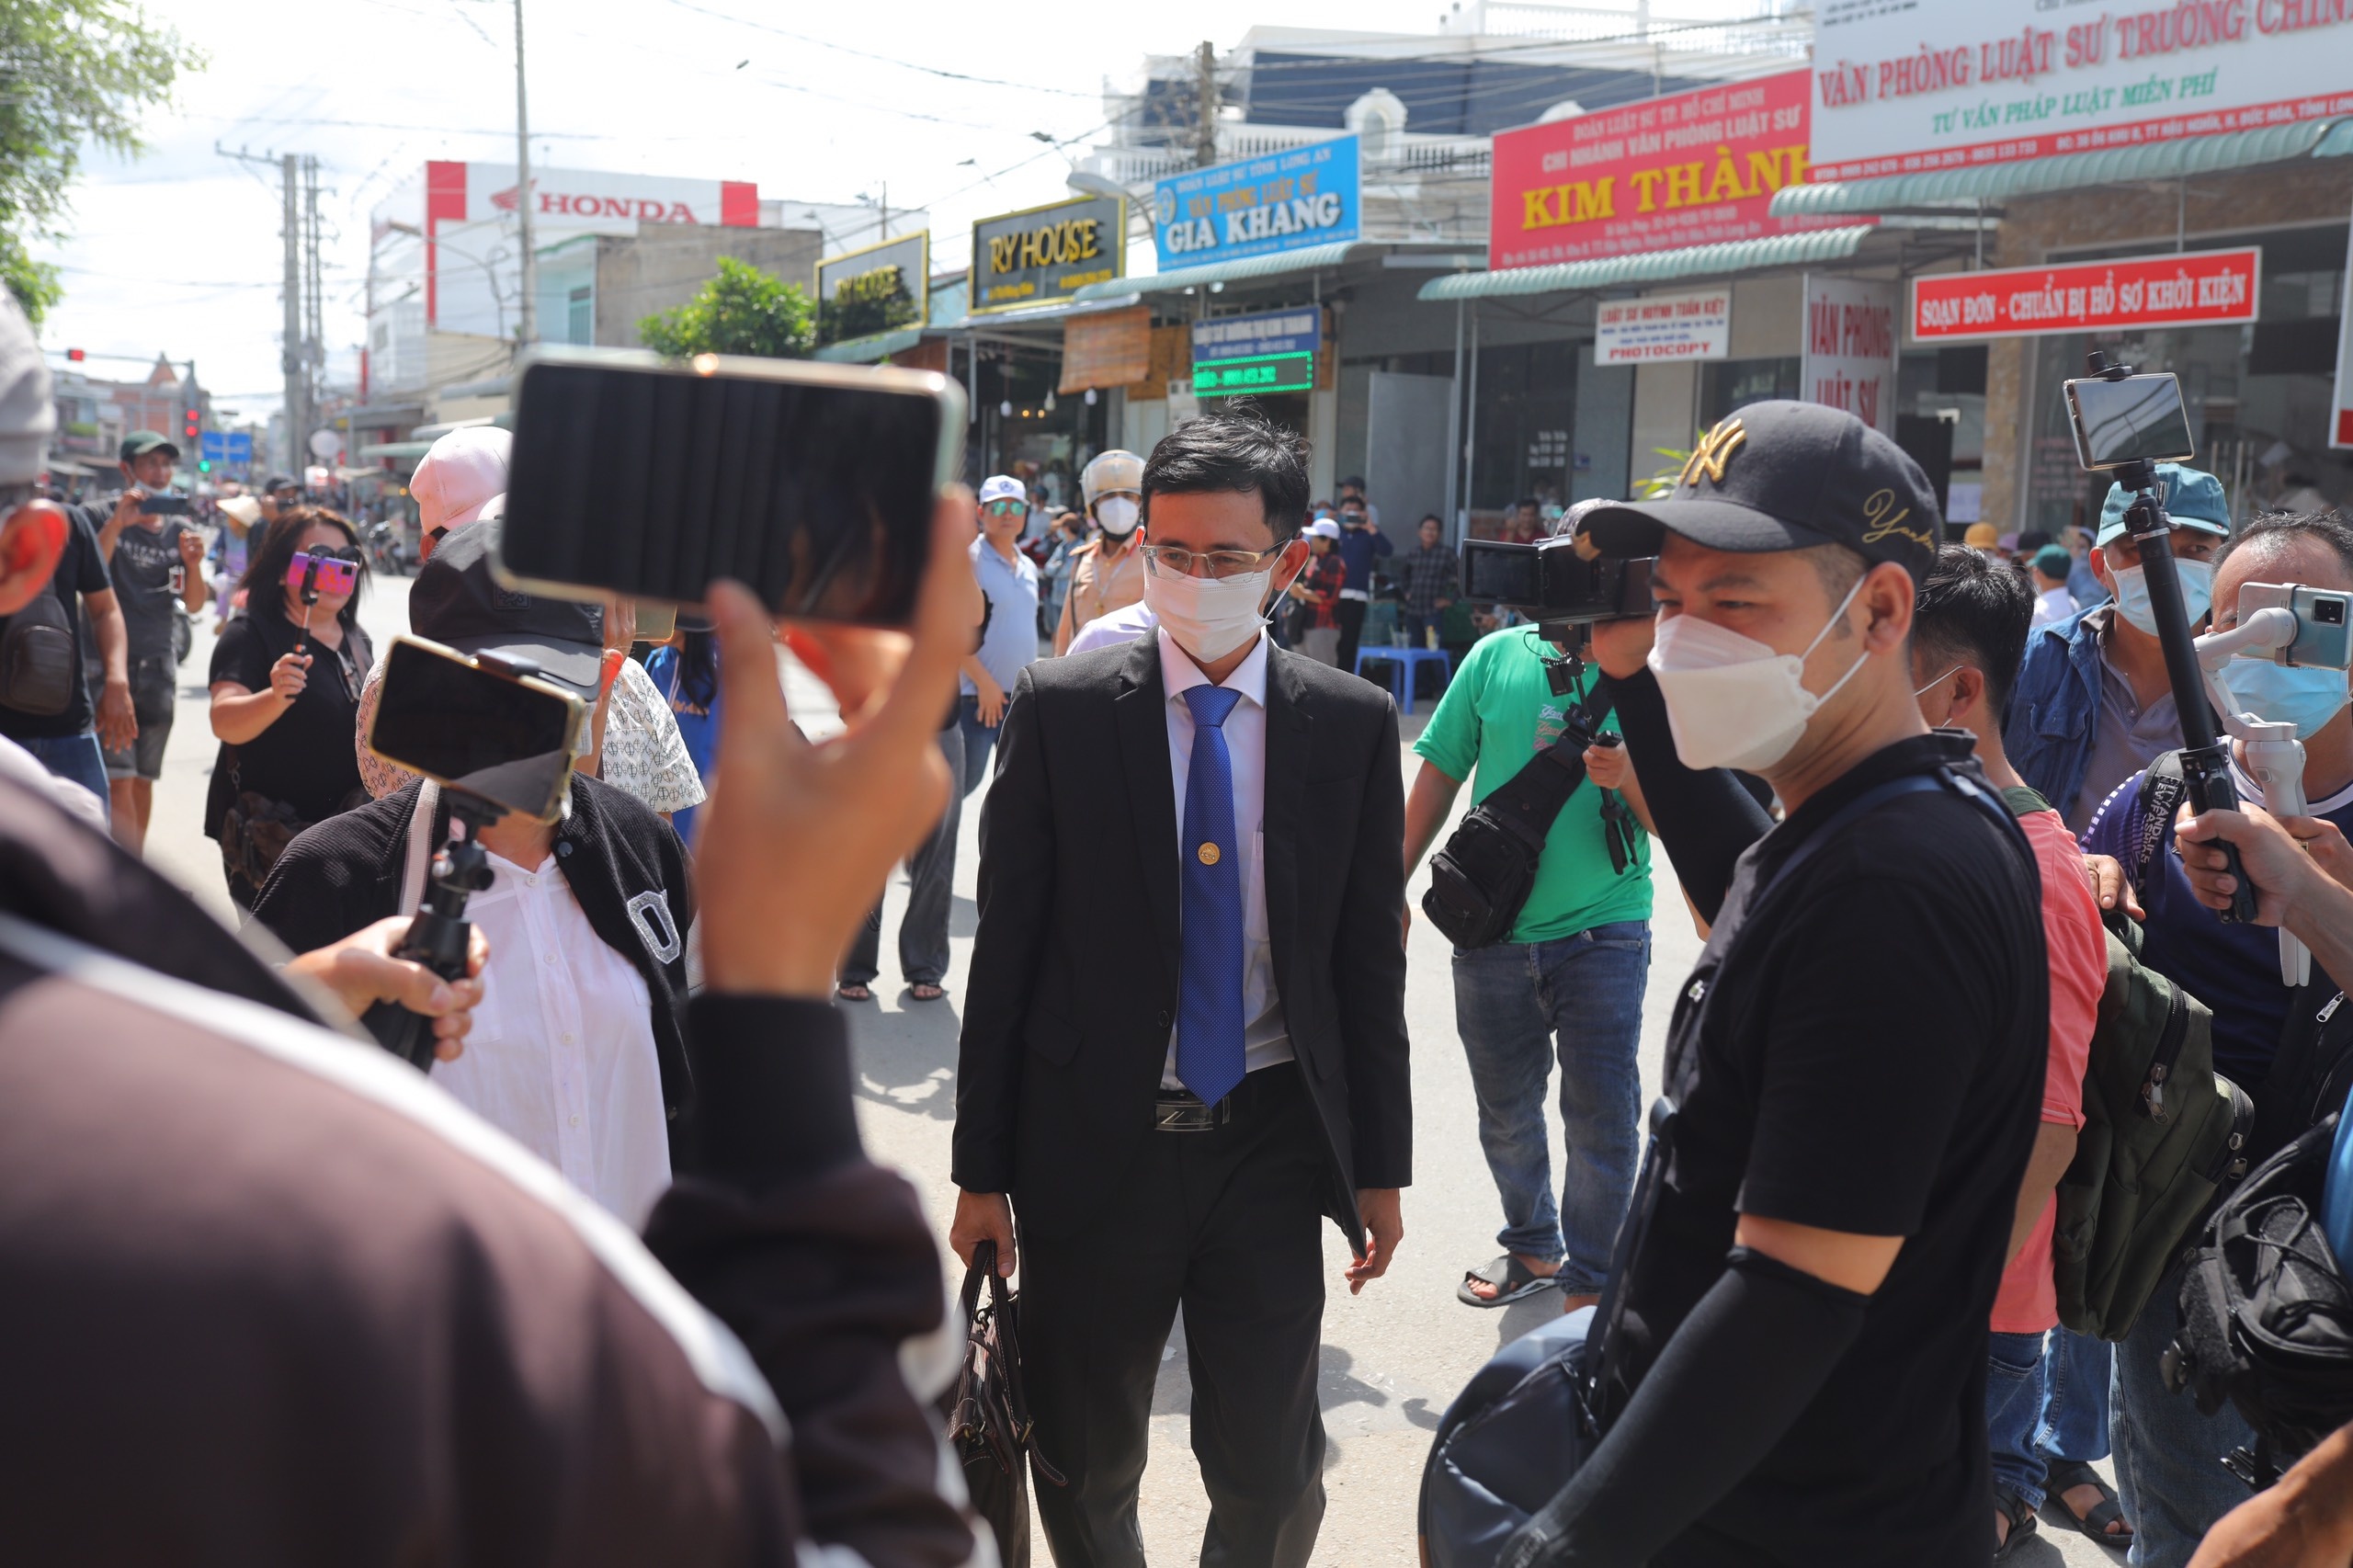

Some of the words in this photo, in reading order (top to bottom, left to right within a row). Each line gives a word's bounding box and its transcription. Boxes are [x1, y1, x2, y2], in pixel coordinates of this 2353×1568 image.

[1819, 57, 1870, 108] VĂN
[1878, 41, 1971, 100] PHÒNG
[1979, 25, 2055, 85] LUẬT
[2065, 12, 2107, 68] SƯ
[1725, 108, 1770, 142] LUẬT
[1774, 102, 1802, 131] SƯ
[2004, 93, 2058, 124] PHÁP
[2062, 85, 2116, 116] LUẬT
[2178, 64, 2219, 99] PHÍ
[539, 192, 698, 223] HONDA
[1165, 216, 1218, 255] GIA
[1225, 191, 1342, 245] KHANG
[1521, 175, 1616, 231] KIM
[988, 231, 1019, 275] RY
[1020, 218, 1098, 270] HOUSE
[1810, 293, 1839, 357] VĂN
[1842, 294, 1893, 359] PHÒNG
[1920, 297, 1961, 332] SOẠN
[1962, 294, 1996, 324] ĐƠN
[2008, 274, 2066, 322] CHUẨN
[2067, 289, 2089, 324] BỊ
[2090, 269, 2114, 313] HỒ
[2119, 283, 2144, 312] SƠ
[2198, 267, 2247, 311] KIỆN
[1608, 341, 1711, 361] PHOTOCOPY
